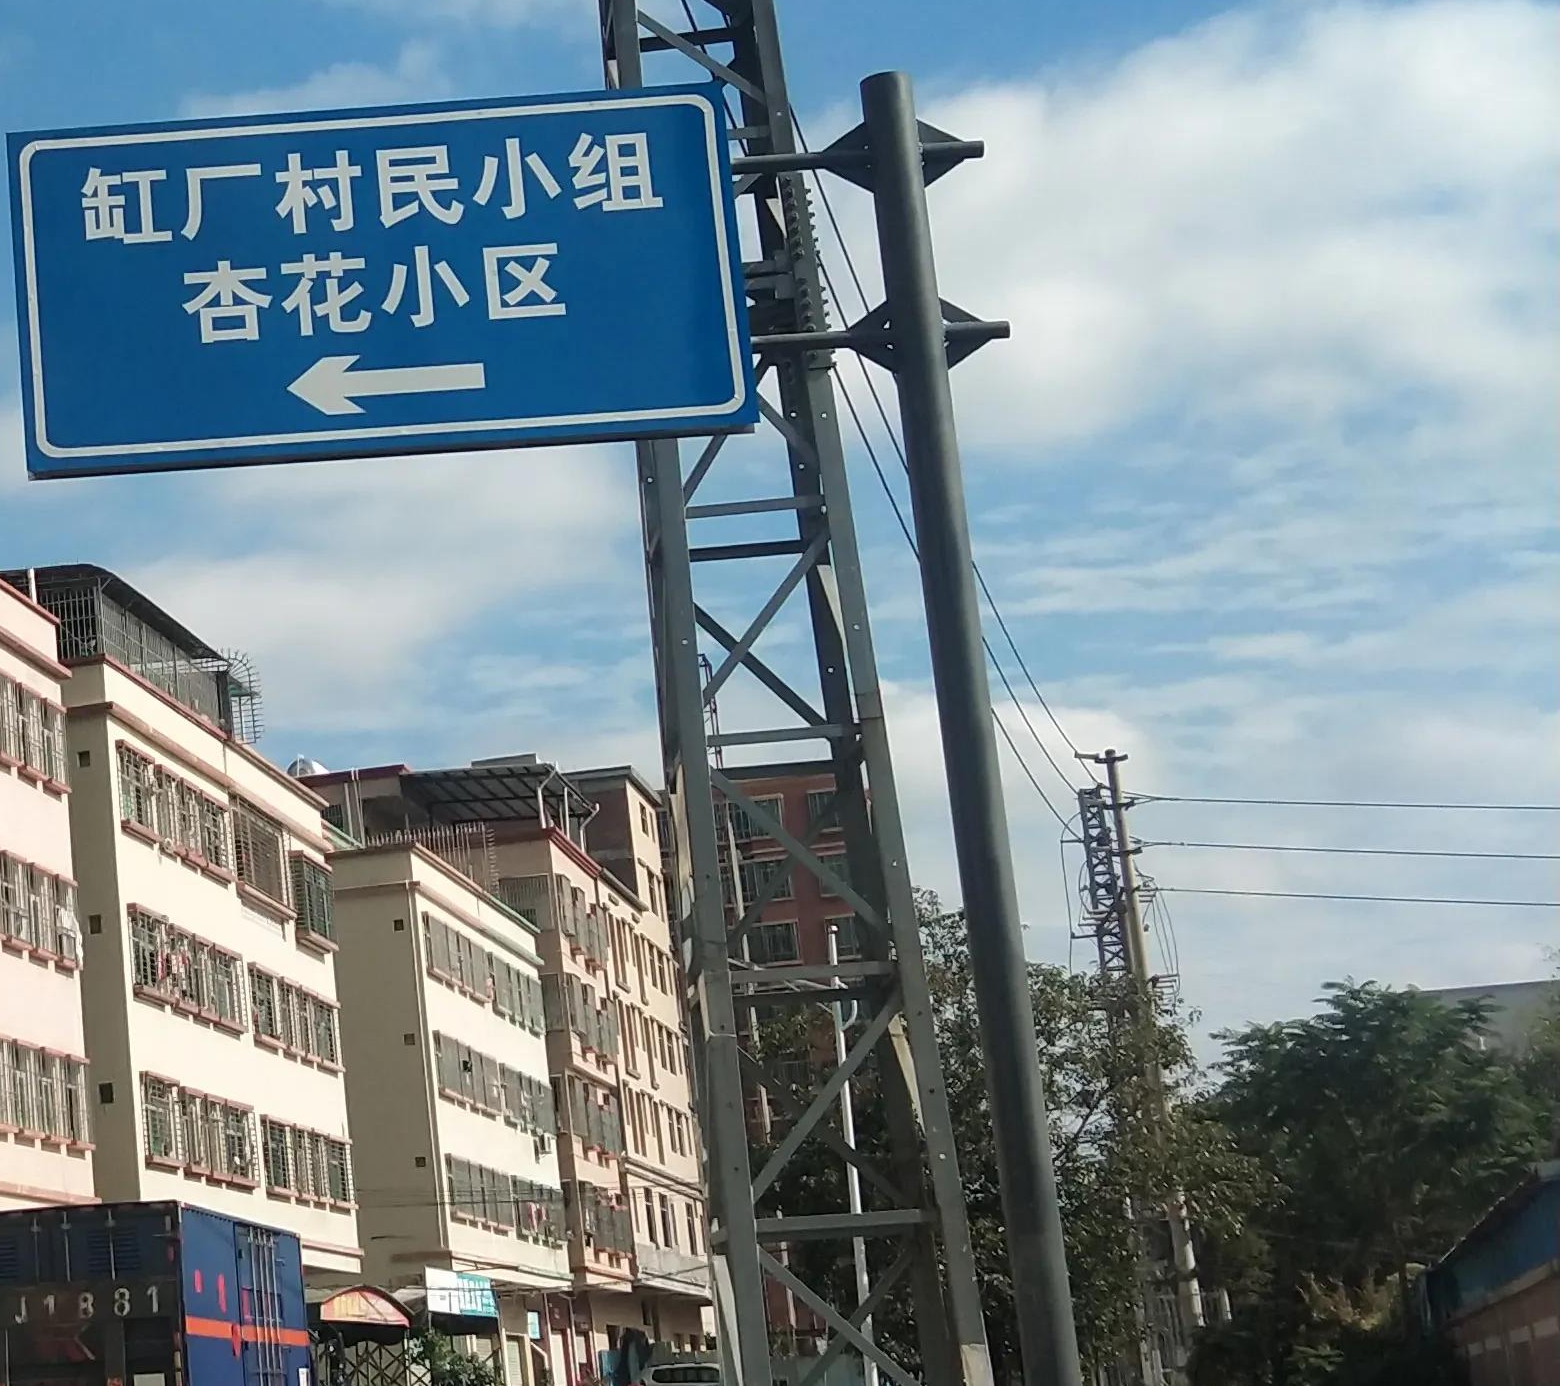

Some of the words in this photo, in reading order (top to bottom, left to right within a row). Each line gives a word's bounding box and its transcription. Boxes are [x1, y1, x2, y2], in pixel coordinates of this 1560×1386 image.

[81, 132, 664, 245] 缸厂村民小组
[183, 242, 567, 344] 杏花小区
